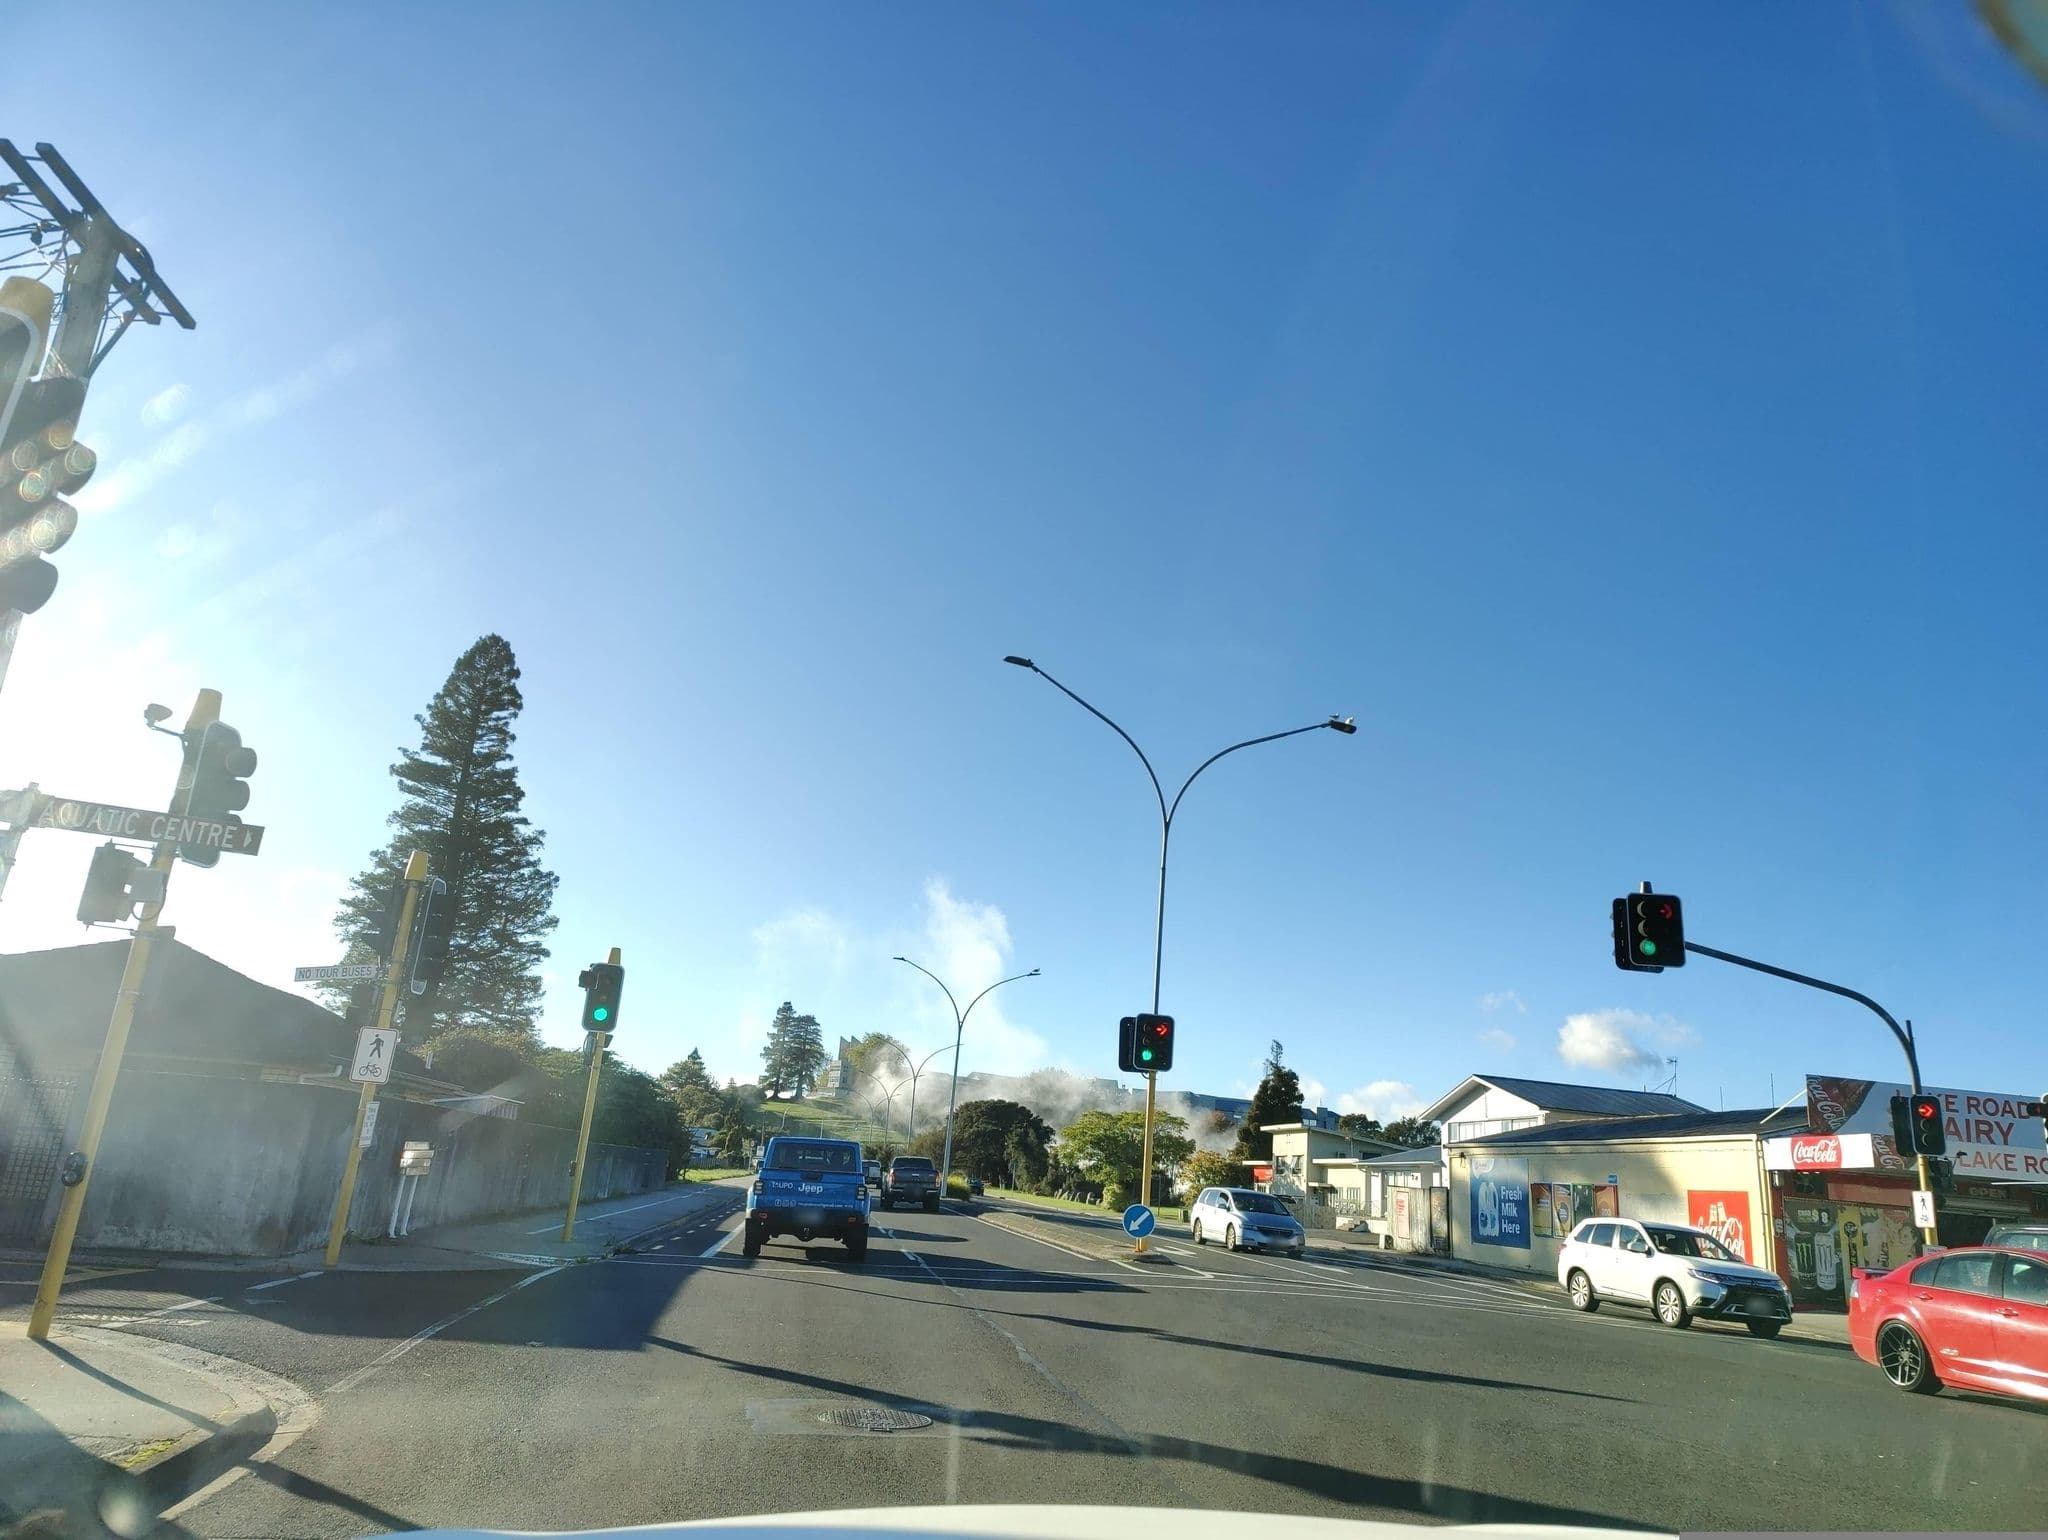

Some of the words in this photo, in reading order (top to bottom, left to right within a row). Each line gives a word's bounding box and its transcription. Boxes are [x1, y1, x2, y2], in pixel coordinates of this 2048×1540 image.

[38, 800, 139, 835] AQUATIC
[150, 816, 237, 848] CENTRE
[298, 969, 312, 979] NO
[315, 967, 338, 978] TOUR
[341, 966, 371, 977] BUSES
[1966, 1096, 2030, 1119] ROAD
[1943, 1116, 2014, 1146] AIRY
[1794, 1139, 1838, 1164] Coca-Cola
[1959, 1151, 2017, 1173] LAKE
[798, 1183, 823, 1194] Jeep
[1500, 1185, 1522, 1201] Fresh
[1501, 1202, 1518, 1218] Milk
[1501, 1219, 1521, 1234] Here
